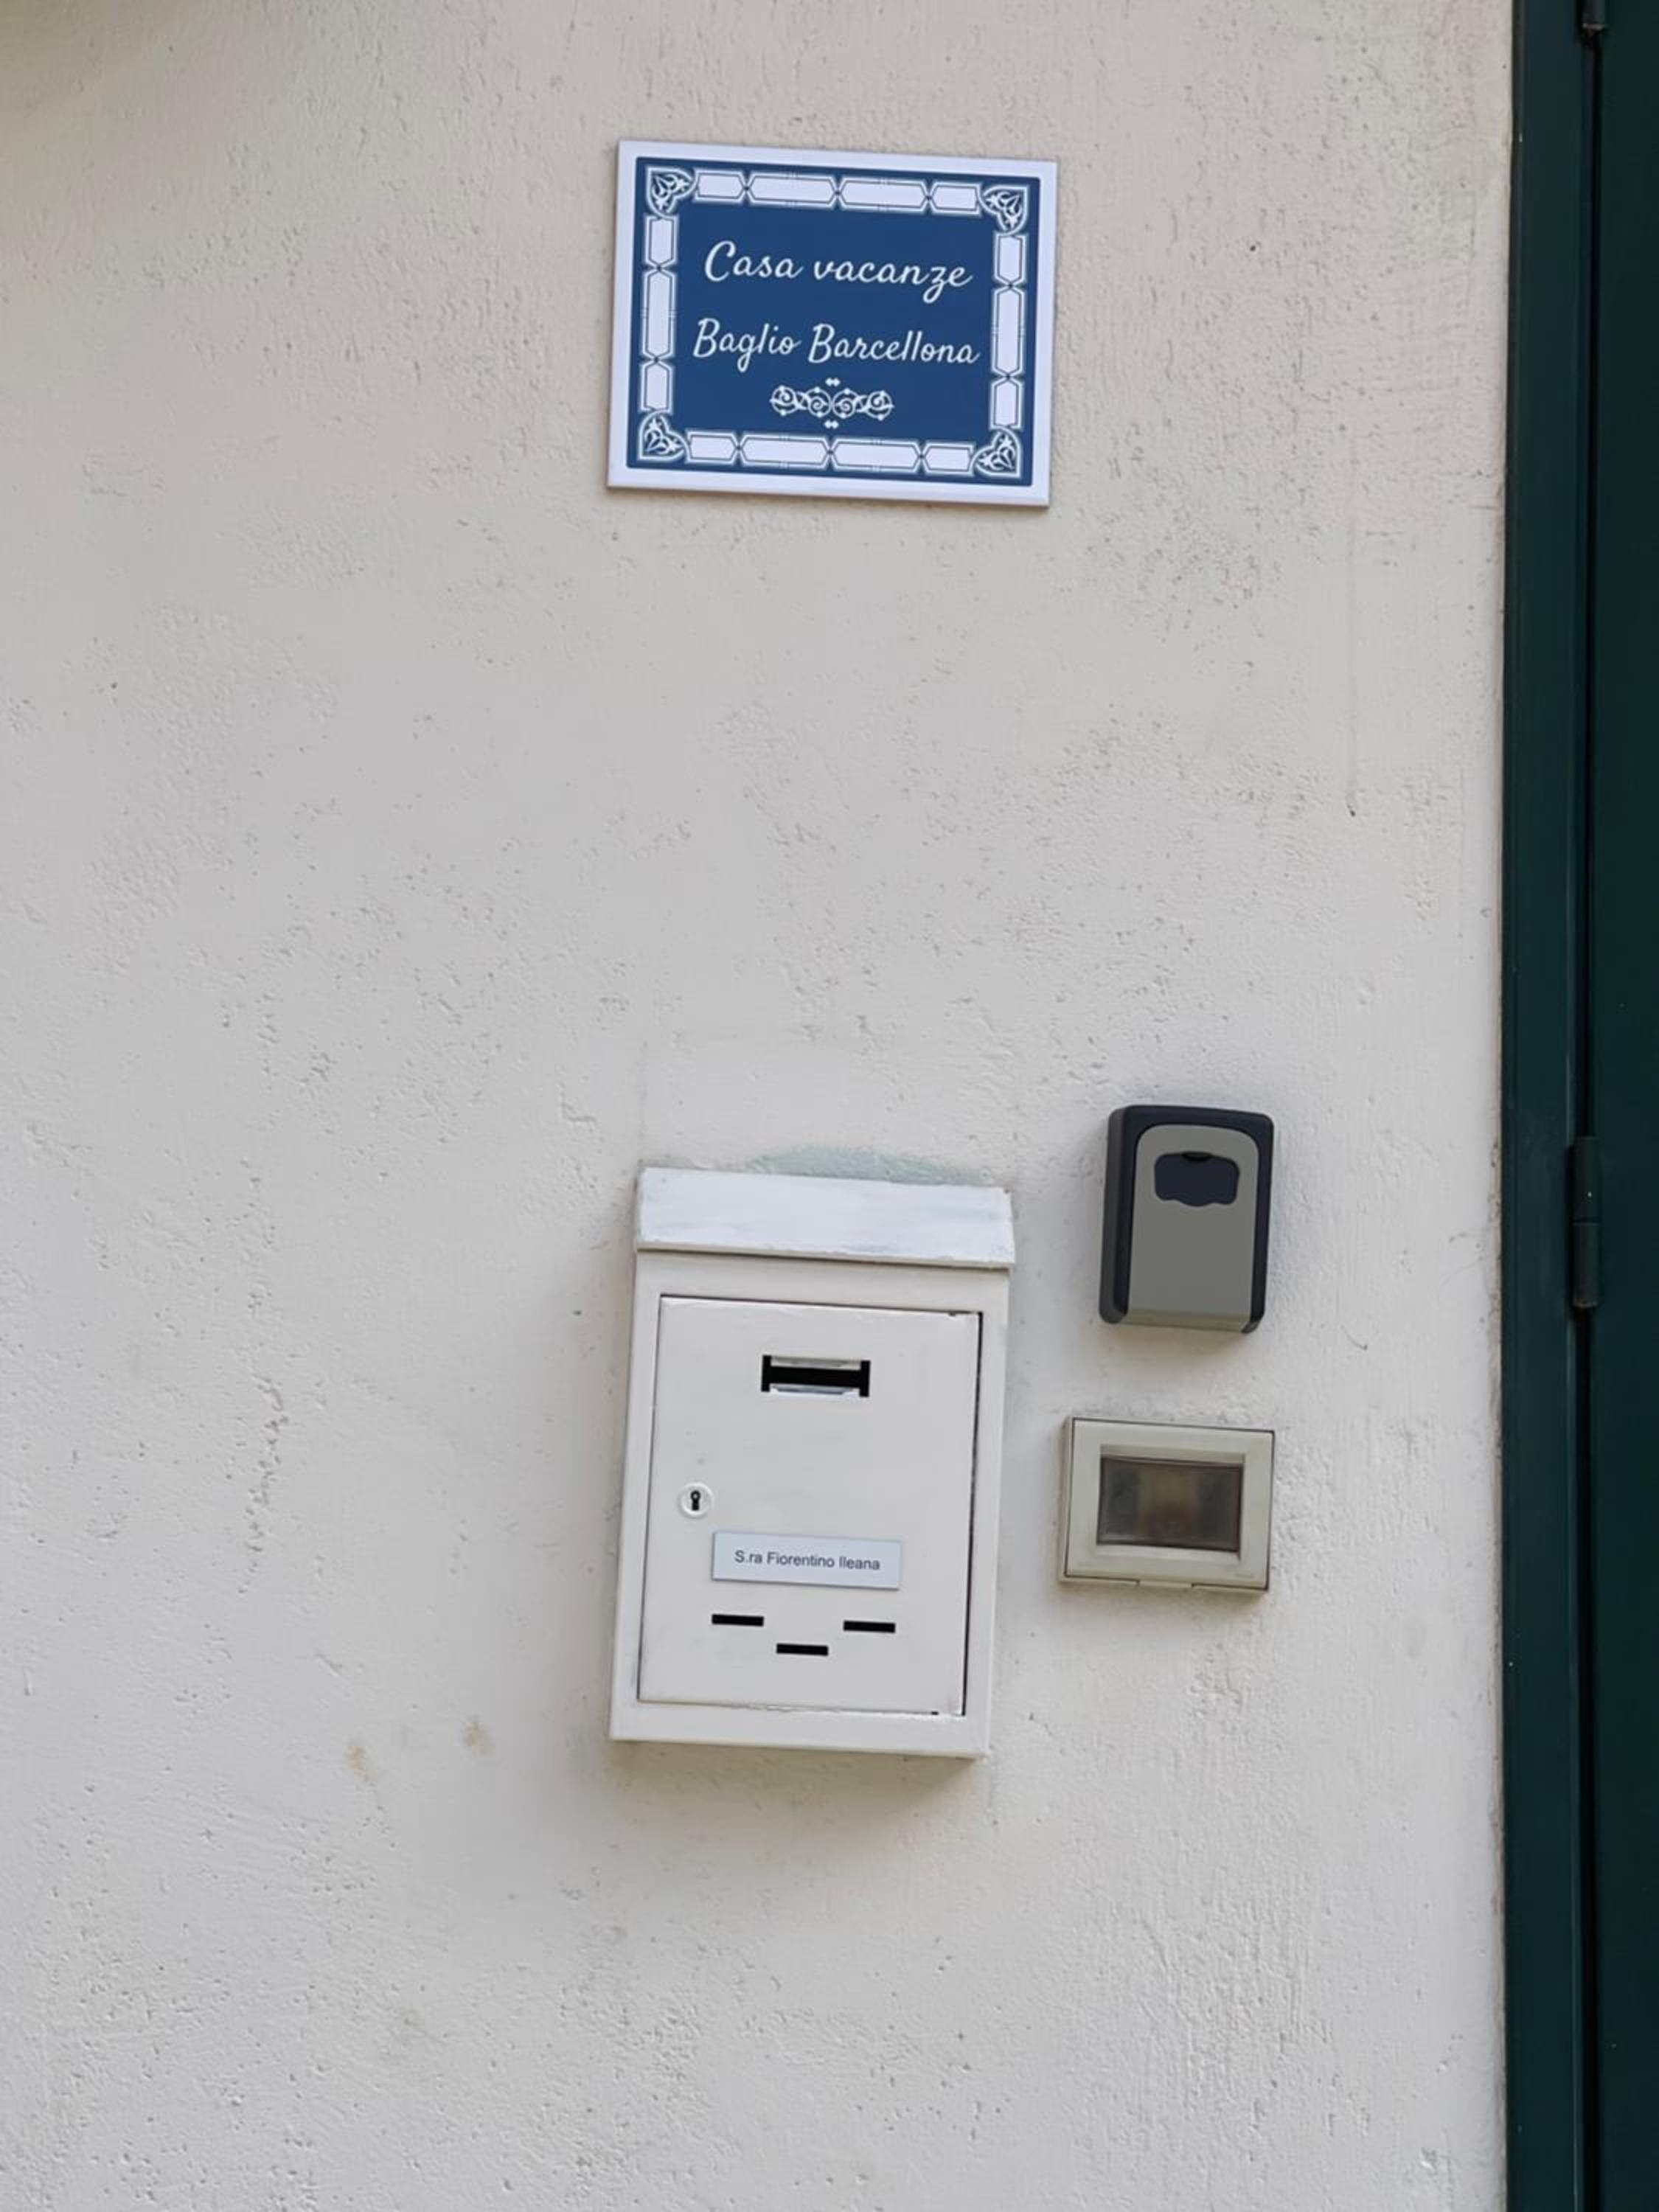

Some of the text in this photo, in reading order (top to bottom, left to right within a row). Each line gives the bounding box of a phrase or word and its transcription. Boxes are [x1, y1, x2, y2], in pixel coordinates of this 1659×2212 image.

[705, 240, 973, 304] Casa vacanze
[693, 318, 981, 372] Baglio Barcellona
[734, 1550, 881, 1571] S.ra Fiorentino Ileana
